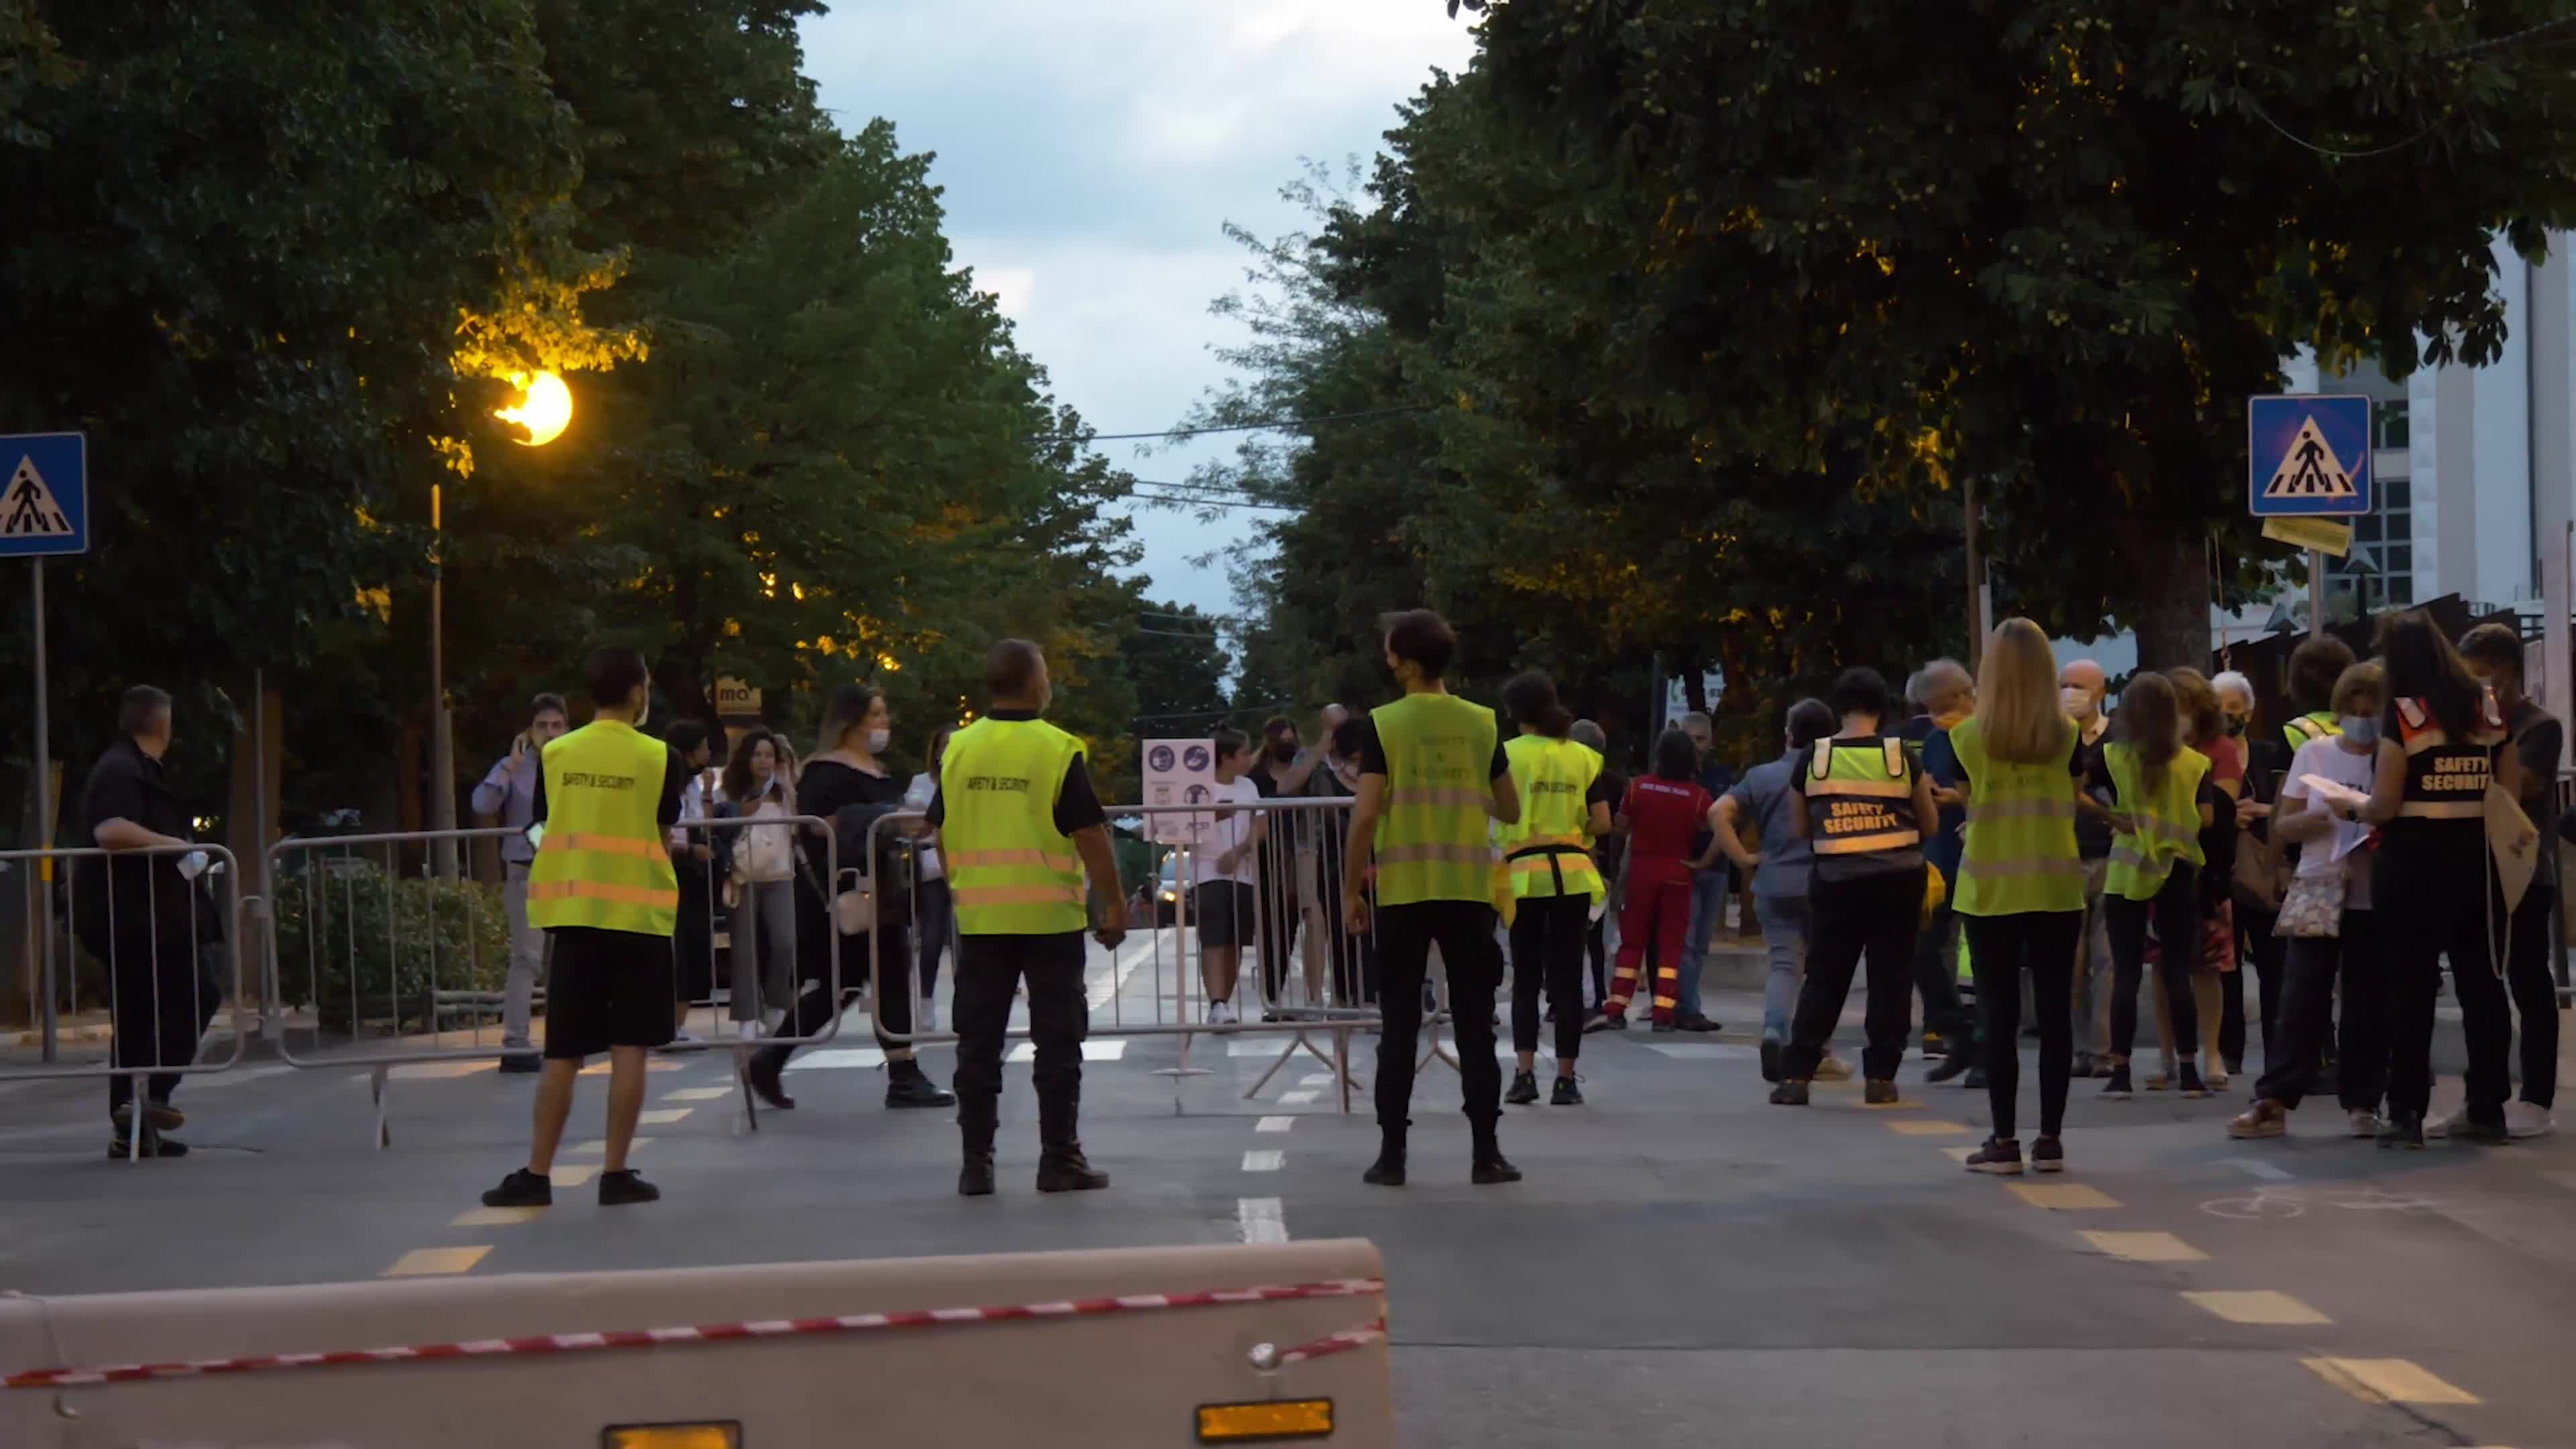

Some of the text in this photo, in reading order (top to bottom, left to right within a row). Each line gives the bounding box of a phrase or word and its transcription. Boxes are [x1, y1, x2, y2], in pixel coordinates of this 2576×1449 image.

[562, 772, 590, 787] SAFETY
[598, 775, 635, 790] SECURITY
[998, 777, 1030, 792] SECURITY
[2421, 774, 2489, 790] SECURIT
[1831, 802, 1884, 817] SAFETY
[1823, 812, 1898, 834] SECURITY
